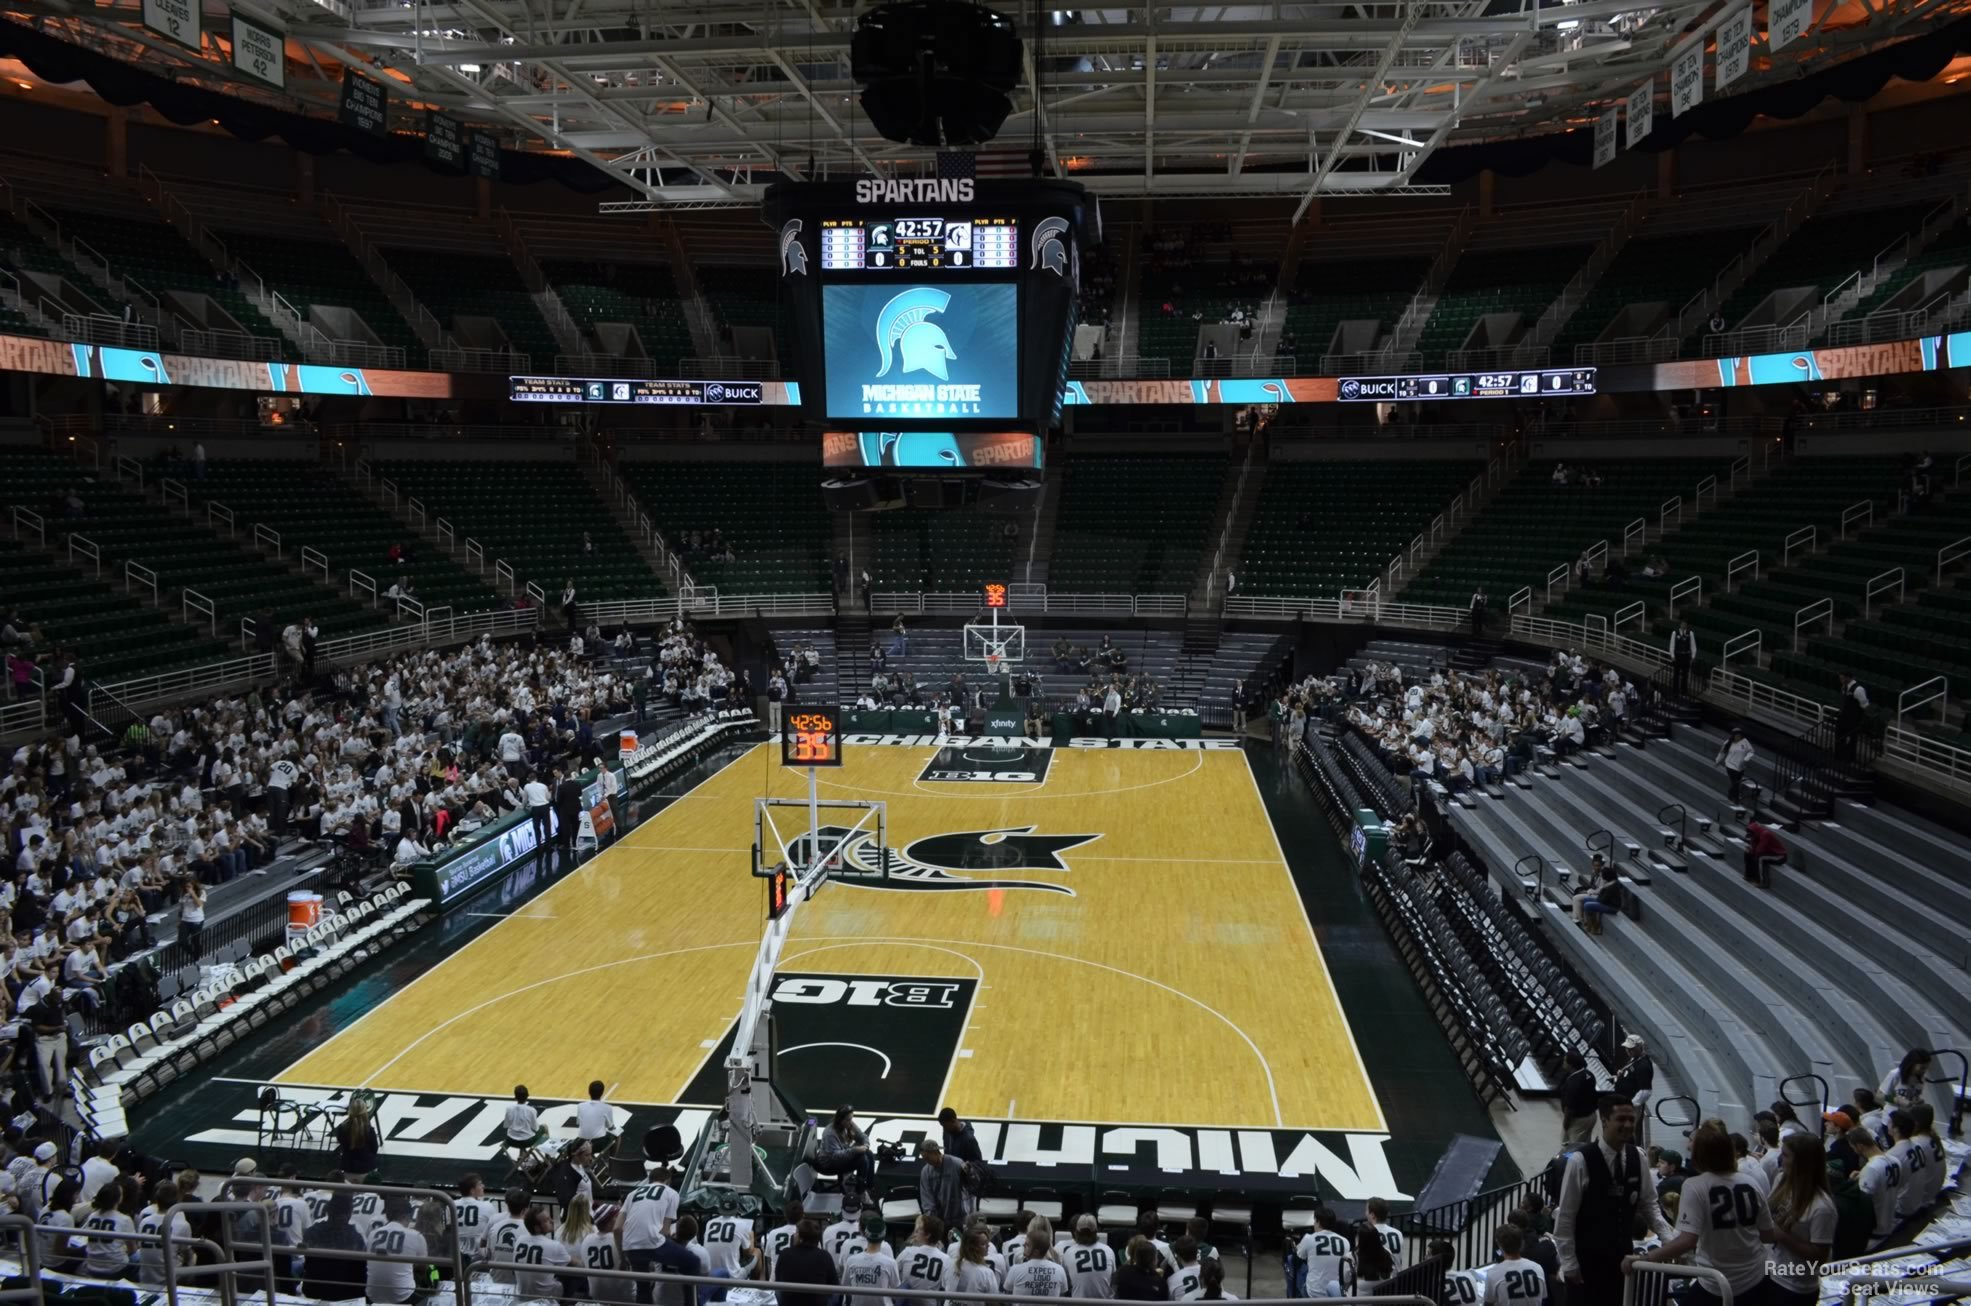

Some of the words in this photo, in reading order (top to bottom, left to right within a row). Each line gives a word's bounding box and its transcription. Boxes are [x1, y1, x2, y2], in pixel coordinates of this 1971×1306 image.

[168, 17, 180, 37] 12
[1782, 19, 1800, 42] 1979
[242, 40, 276, 64] PETERSON
[253, 59, 267, 77] 42
[855, 178, 975, 203] SPARTANS
[895, 221, 943, 237] 42:57
[875, 252, 885, 267] 0
[953, 251, 963, 266] 0
[1815, 341, 1922, 377] SPARTANS
[165, 355, 269, 389] SPARTANS
[1479, 375, 1512, 387] 42:57
[1083, 380, 1194, 403] SPARTANS
[1360, 383, 1394, 394] BUICK
[1428, 381, 1437, 394] 0
[1552, 376, 1561, 389] 0
[725, 388, 758, 398] BUICK
[862, 384, 934, 402] MICHIGAN
[936, 384, 981, 402] STATE
[863, 403, 980, 414] BASKETBALL
[988, 592, 1003, 606] 35
[790, 714, 832, 730] 42:56
[991, 720, 1016, 728] xfinity
[797, 732, 828, 760] 35
[1068, 737, 1240, 750] STATE
[278, 762, 293, 774] 20
[1906, 1145, 1926, 1173] 20
[632, 1185, 665, 1202] 20
[353, 1196, 377, 1214] 20
[1708, 1183, 1760, 1230] 20
[456, 1205, 479, 1226] 20
[372, 1230, 405, 1253] 20
[707, 1222, 736, 1243] 20
[515, 1243, 543, 1264] 20
[1315, 1235, 1345, 1256] 20
[587, 1244, 614, 1269] 20
[1075, 1249, 1108, 1274] 20
[874, 1265, 882, 1276] 4
[911, 1253, 943, 1282] 20
[855, 1274, 878, 1284] MSU
[1504, 1269, 1540, 1300] 20
[1446, 1276, 1476, 1304] 20
